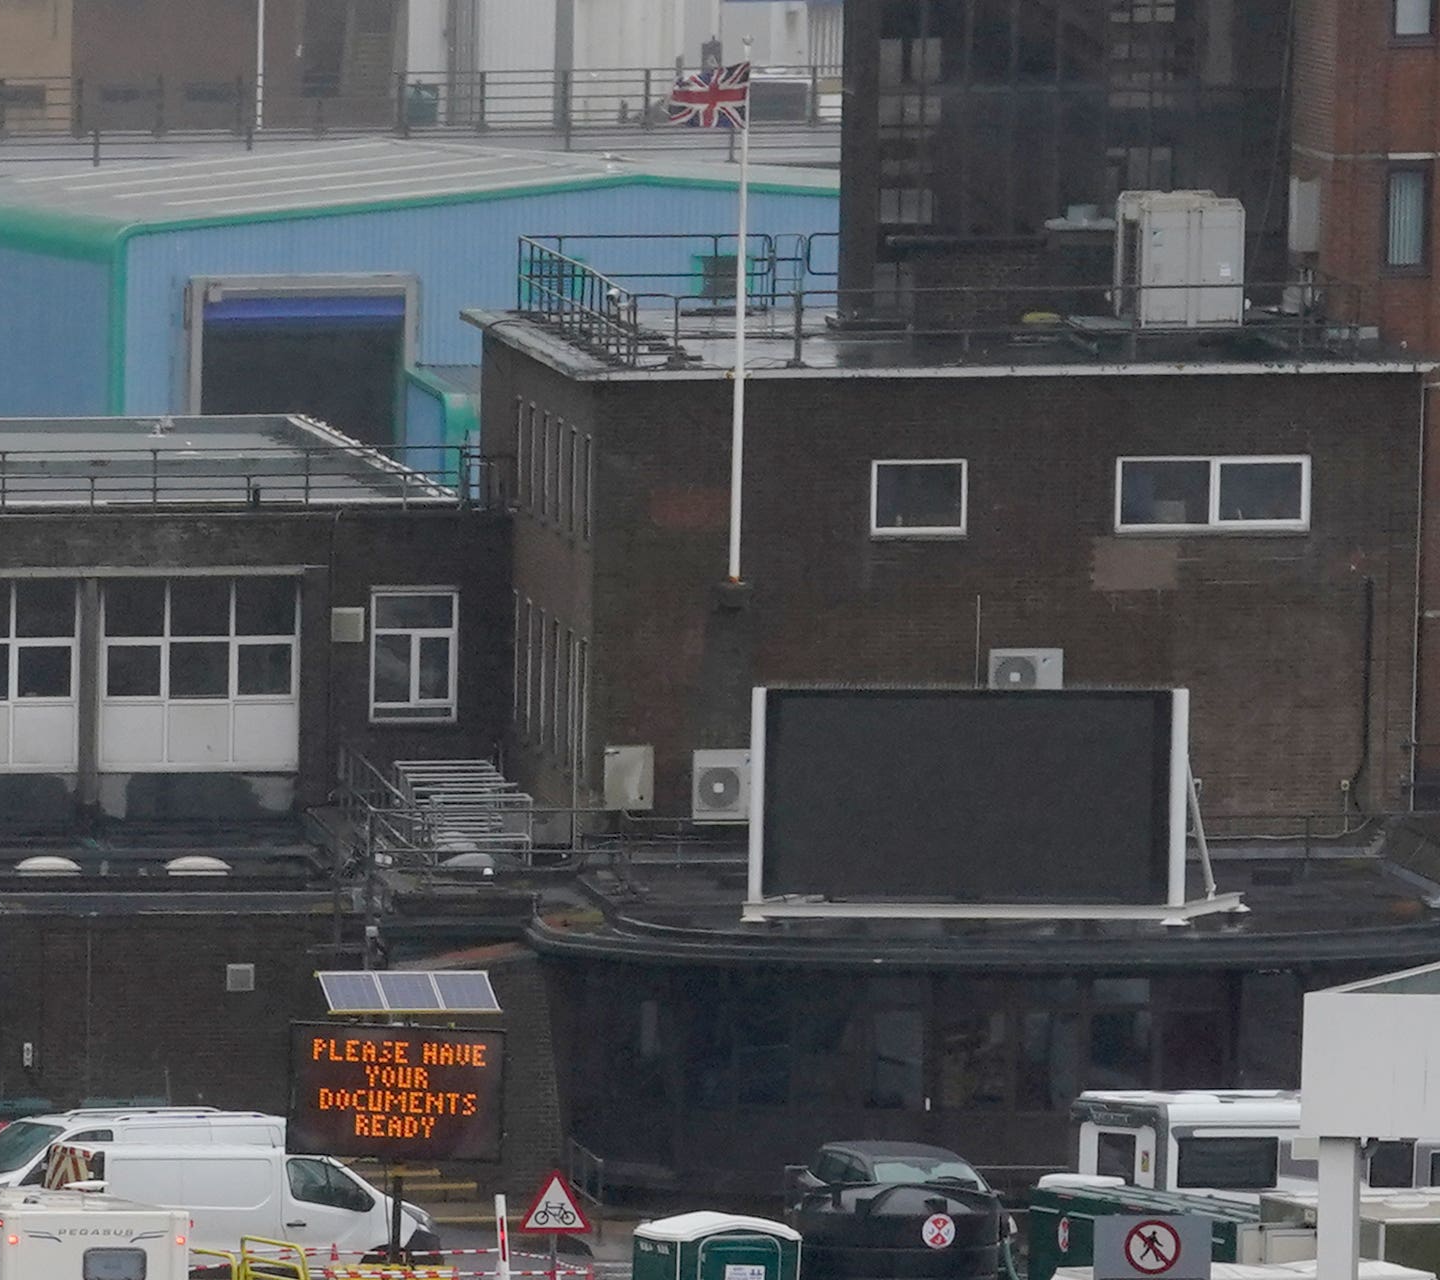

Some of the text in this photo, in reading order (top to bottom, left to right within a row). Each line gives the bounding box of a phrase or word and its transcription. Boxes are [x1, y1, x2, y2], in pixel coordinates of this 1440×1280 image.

[312, 1038, 486, 1066] PLEASE HAVE
[365, 1066, 428, 1090] YOUR
[319, 1088, 477, 1116] DOCUMENTS
[355, 1114, 435, 1138] READY
[58, 1228, 134, 1237] PEGASUS
